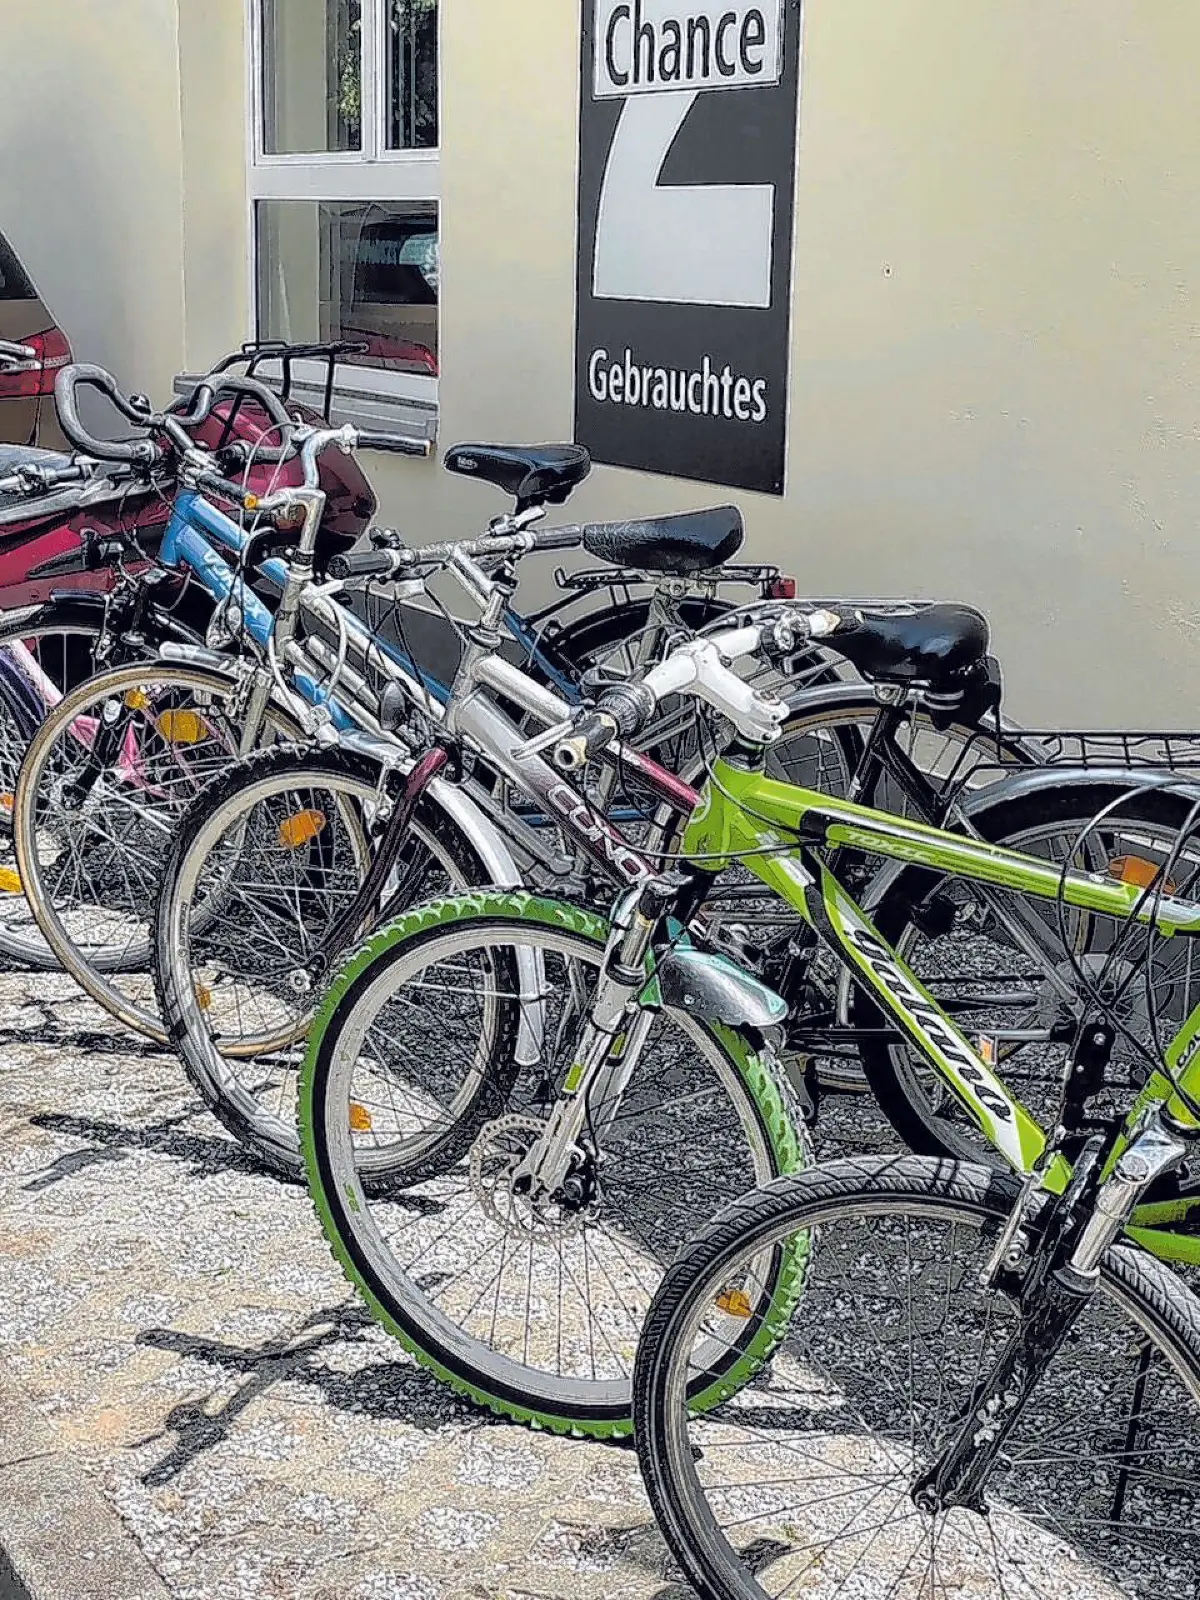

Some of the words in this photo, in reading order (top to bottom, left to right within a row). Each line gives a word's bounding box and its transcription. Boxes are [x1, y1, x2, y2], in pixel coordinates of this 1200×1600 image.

[605, 0, 765, 86] Chance
[589, 348, 767, 421] Gebrauchtes
[843, 928, 1012, 1123] Galano
